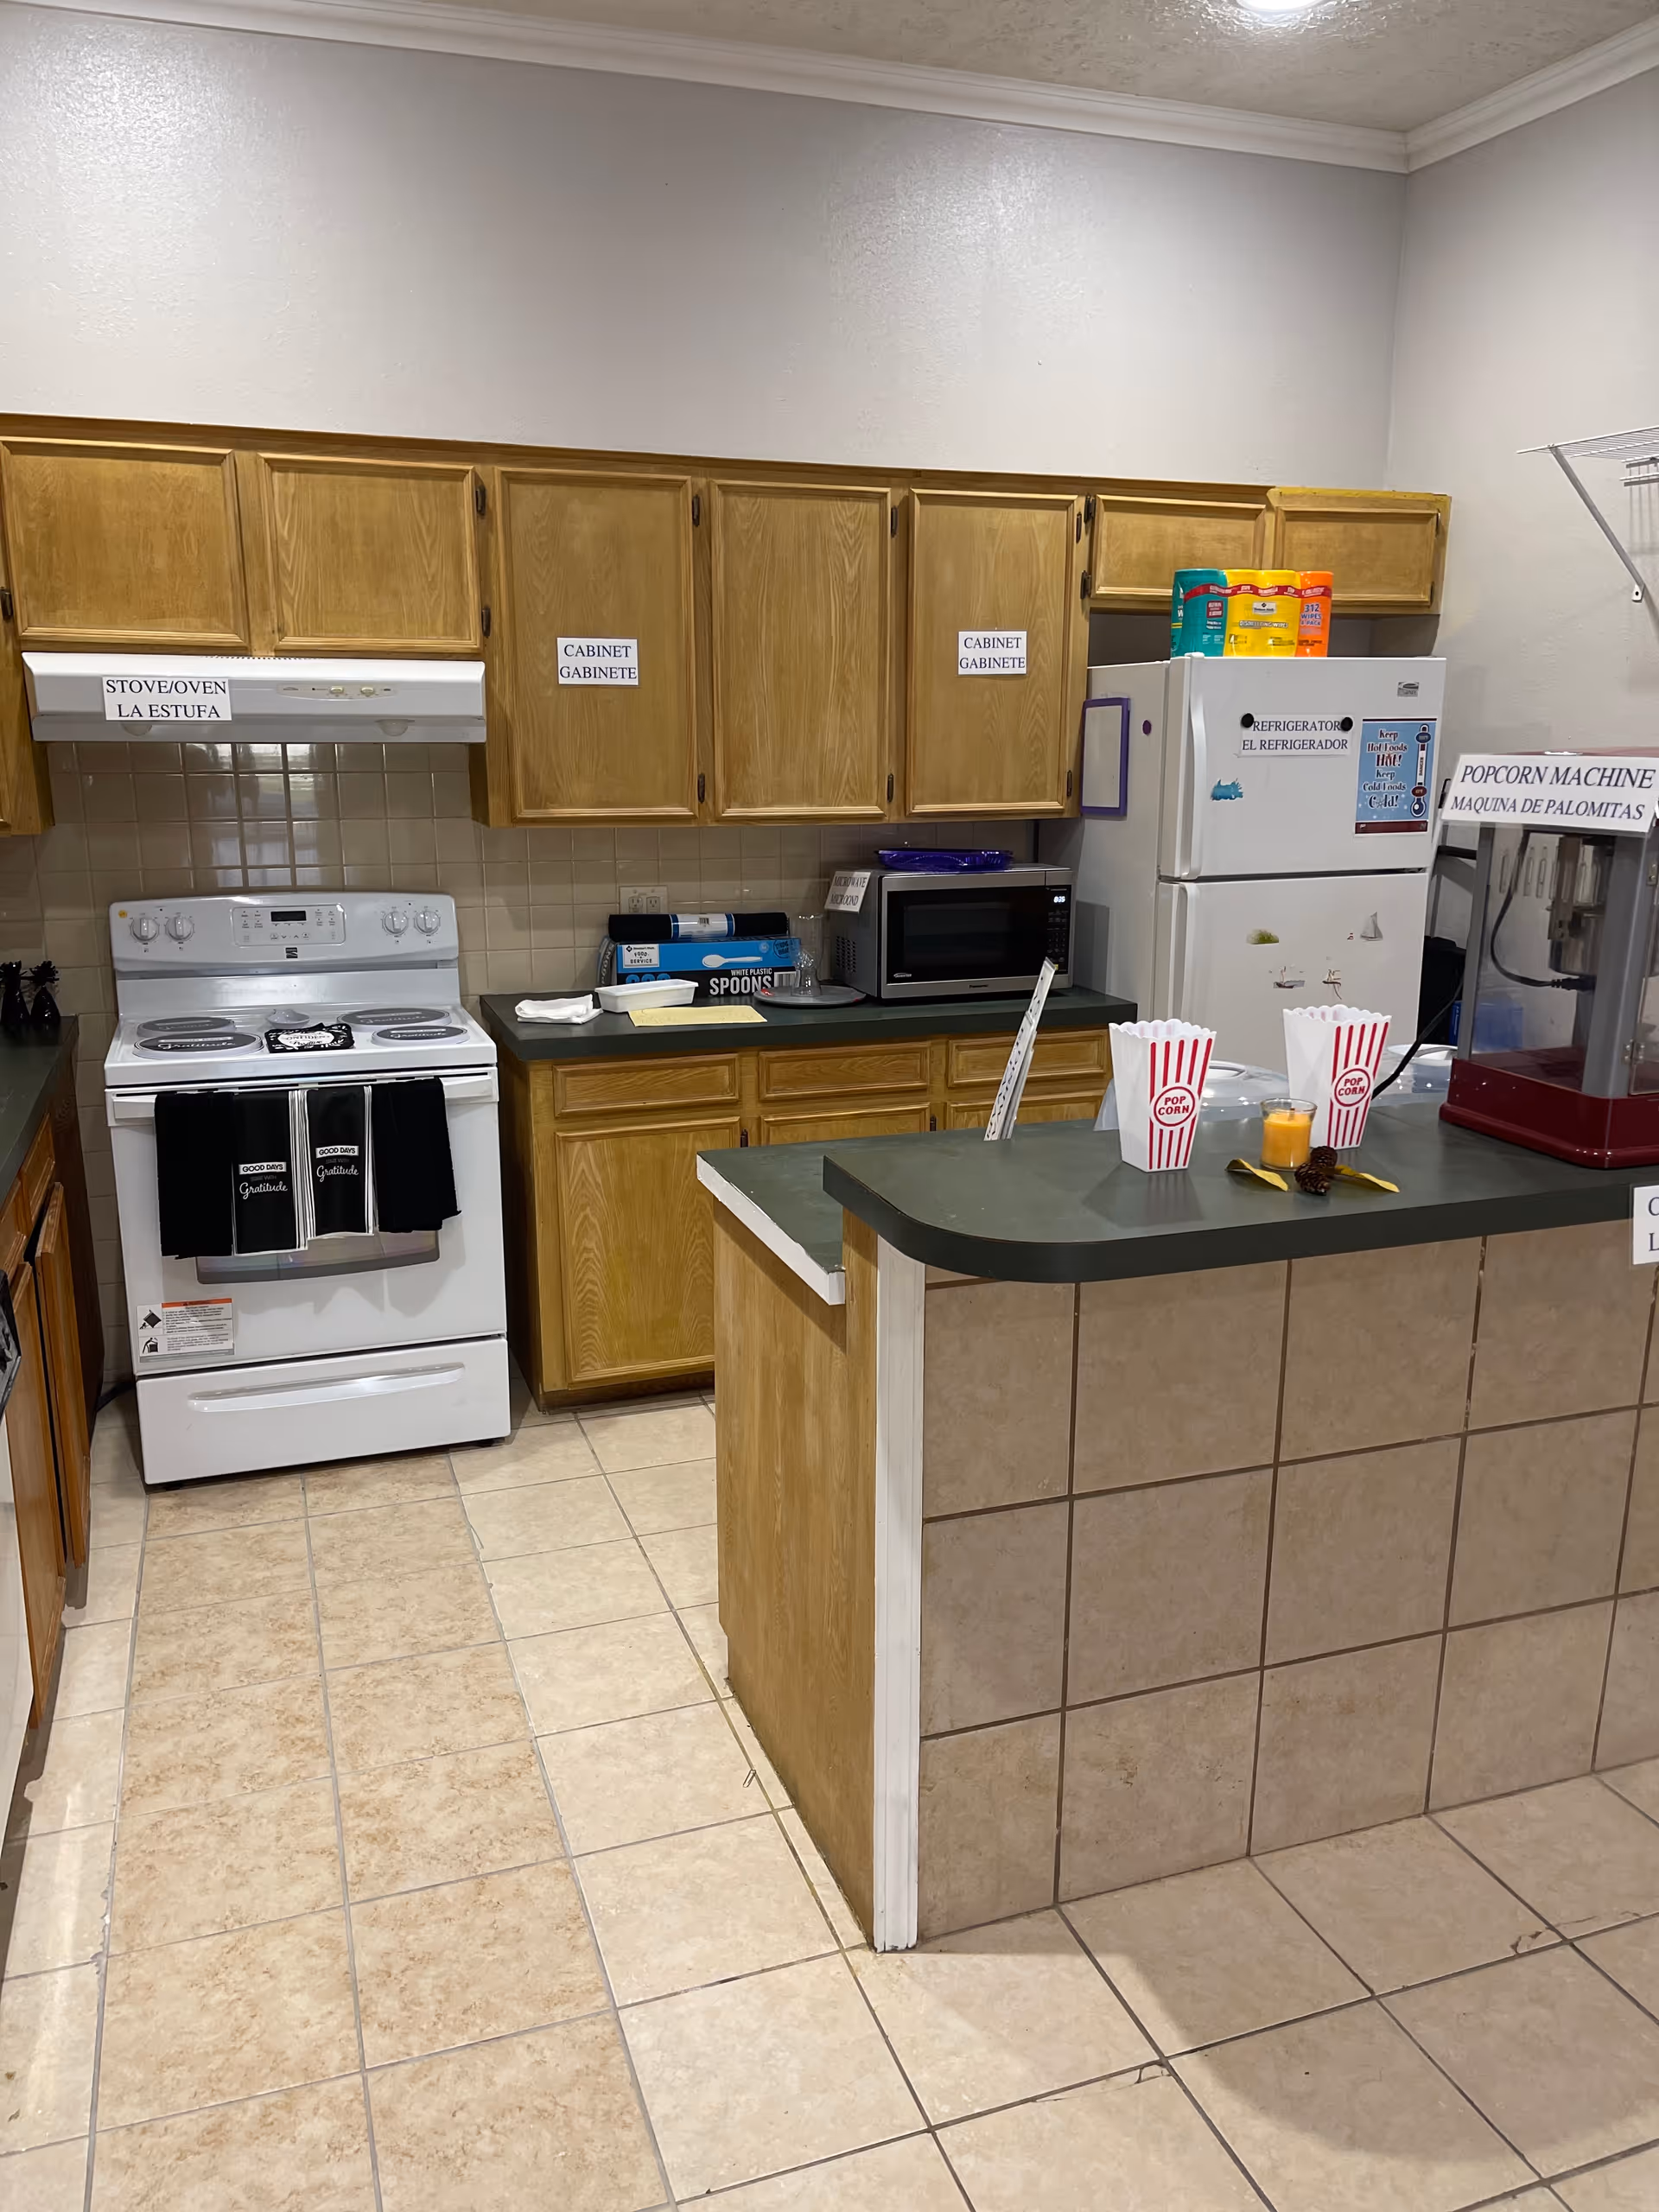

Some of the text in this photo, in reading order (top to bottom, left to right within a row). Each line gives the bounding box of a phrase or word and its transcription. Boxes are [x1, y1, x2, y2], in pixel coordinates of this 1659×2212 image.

[1305, 603, 1319, 613] 312
[963, 637, 1022, 649] CABINET
[563, 644, 632, 658] CABINET
[959, 657, 1026, 669] GABINETE
[559, 665, 637, 679] GABINETE
[105, 679, 226, 695] STOVE/OVEN
[118, 703, 220, 718] LA ESTUFA
[1253, 721, 1341, 732] REFRIGERATOR
[1379, 730, 1398, 741] Keep
[1243, 739, 1348, 750] EL REFRIGERADOR
[1367, 743, 1408, 752] Hot Foods
[1376, 753, 1402, 767] Hot!
[1376, 770, 1395, 780] Keep
[1460, 765, 1656, 789] POPCORN MACHINE
[1363, 783, 1381, 791] Cold
[1383, 783, 1406, 791] Foods
[1450, 796, 1645, 820] MAQUINA DE PALOMITAS
[709, 976, 772, 995] SPOONS
[1344, 1077, 1363, 1086] POP
[1338, 1086, 1366, 1096] CORN
[1164, 1096, 1186, 1105] POP
[1158, 1105, 1191, 1116] CORN
[316, 1165, 359, 1182] Gratitude
[239, 1181, 289, 1199] Gratitude
